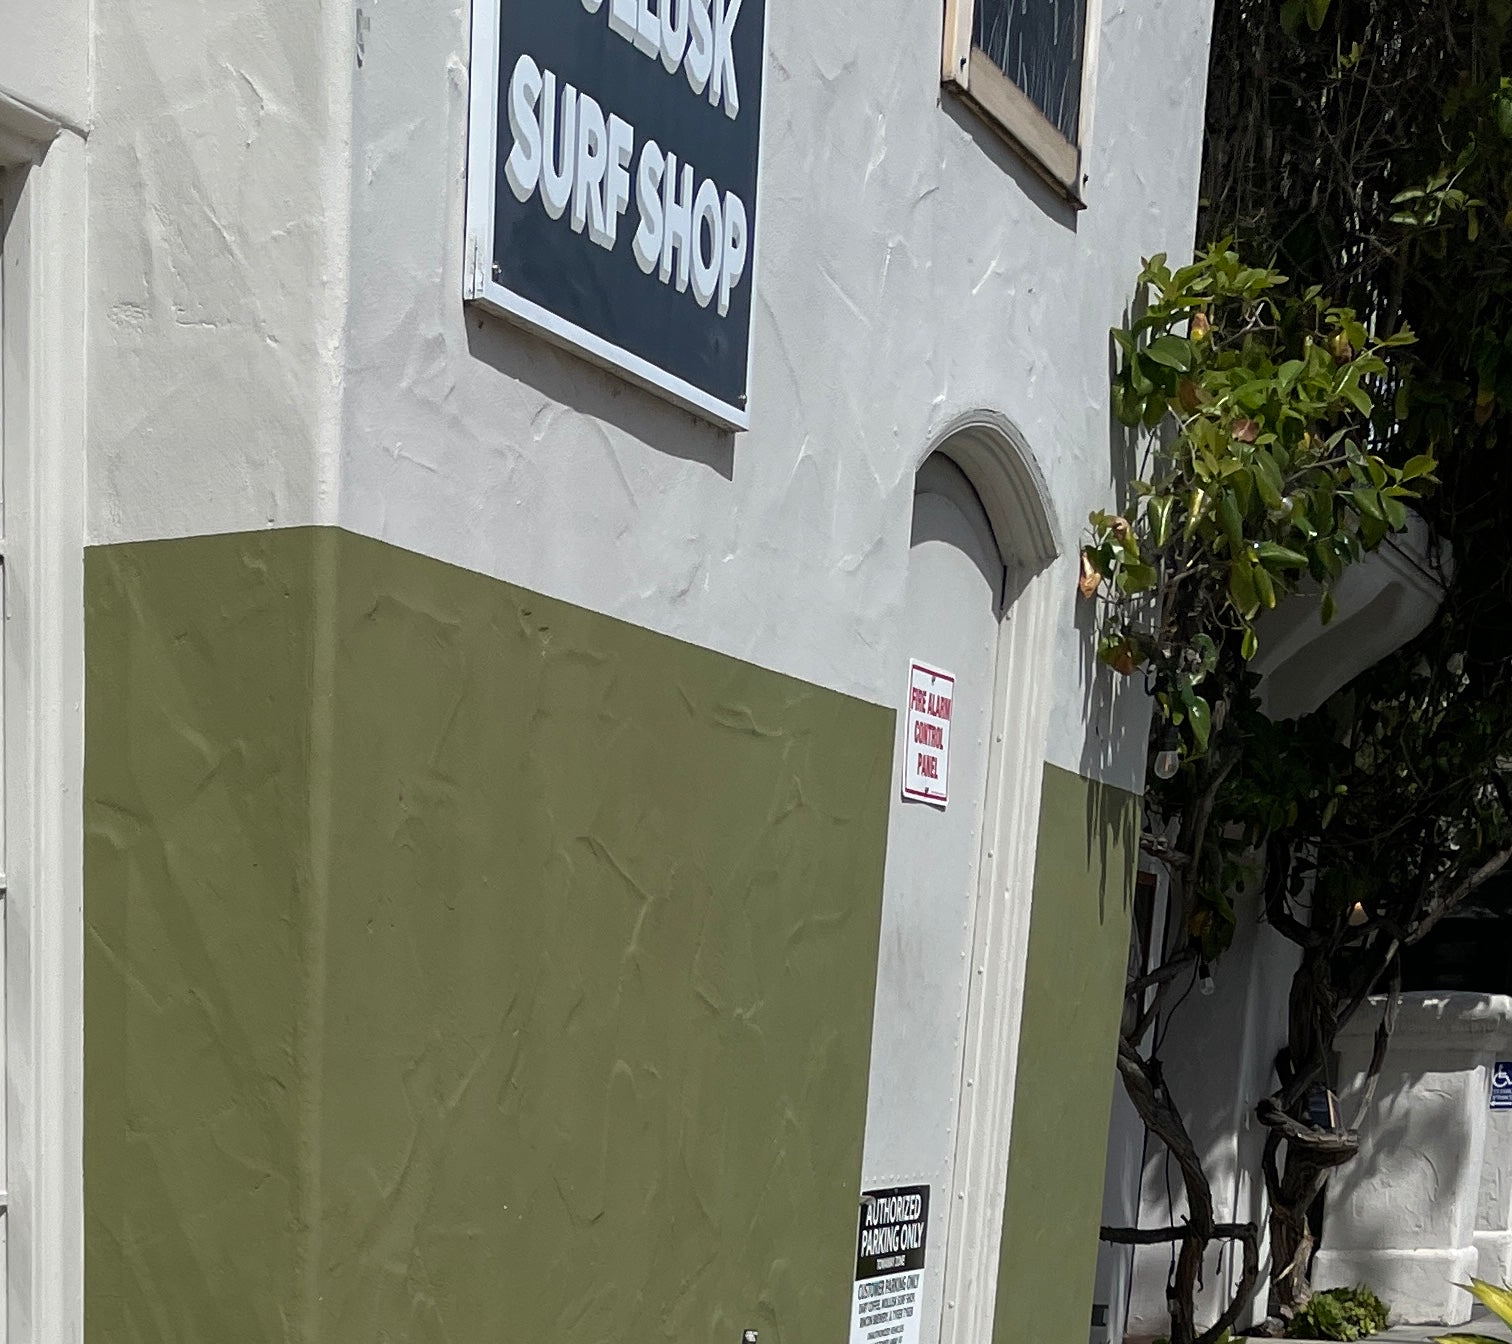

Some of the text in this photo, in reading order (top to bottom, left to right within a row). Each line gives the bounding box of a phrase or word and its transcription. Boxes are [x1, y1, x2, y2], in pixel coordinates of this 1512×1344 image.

[504, 54, 748, 319] SURF SHOP
[910, 687, 952, 721] FIRE ALARM
[914, 720, 944, 750] CONTROL
[917, 752, 938, 779] PANEL
[866, 1194, 921, 1226] AUTHORIZED
[861, 1222, 925, 1257] PARKING ONLY
